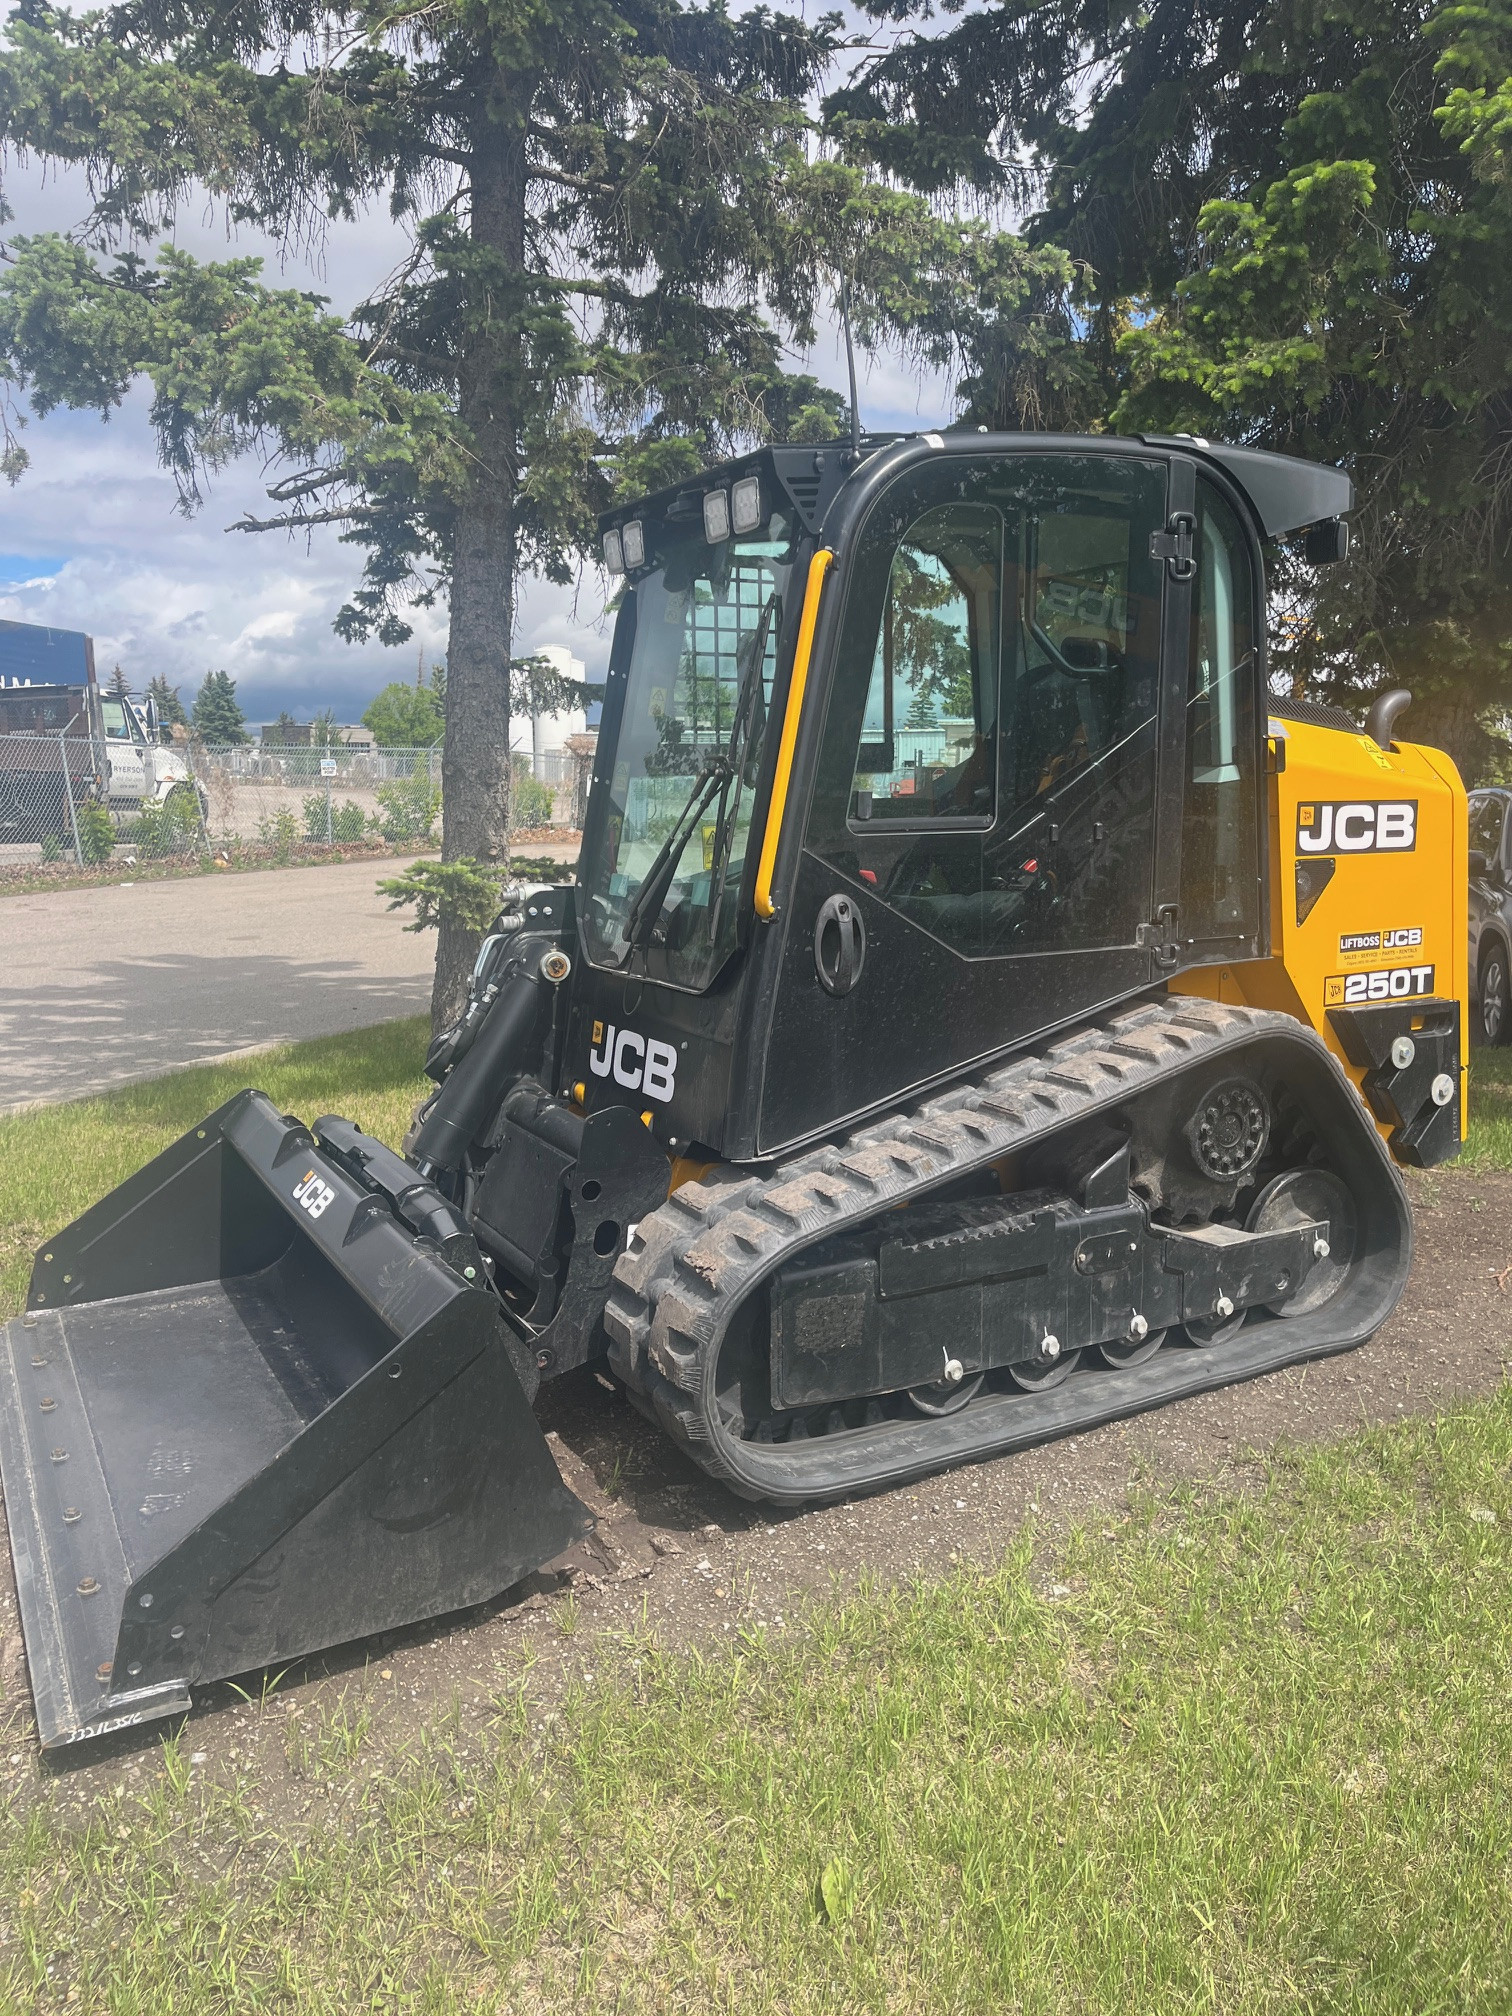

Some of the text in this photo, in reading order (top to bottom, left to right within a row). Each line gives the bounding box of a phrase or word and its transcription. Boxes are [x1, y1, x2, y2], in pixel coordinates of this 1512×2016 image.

[1298, 804, 1415, 852] JCB
[1340, 935, 1380, 950] LIFTBOSS
[1383, 929, 1422, 948] JCB
[1344, 966, 1432, 1003] 250T
[589, 1024, 678, 1103] JCB
[292, 1174, 335, 1219] JCB
